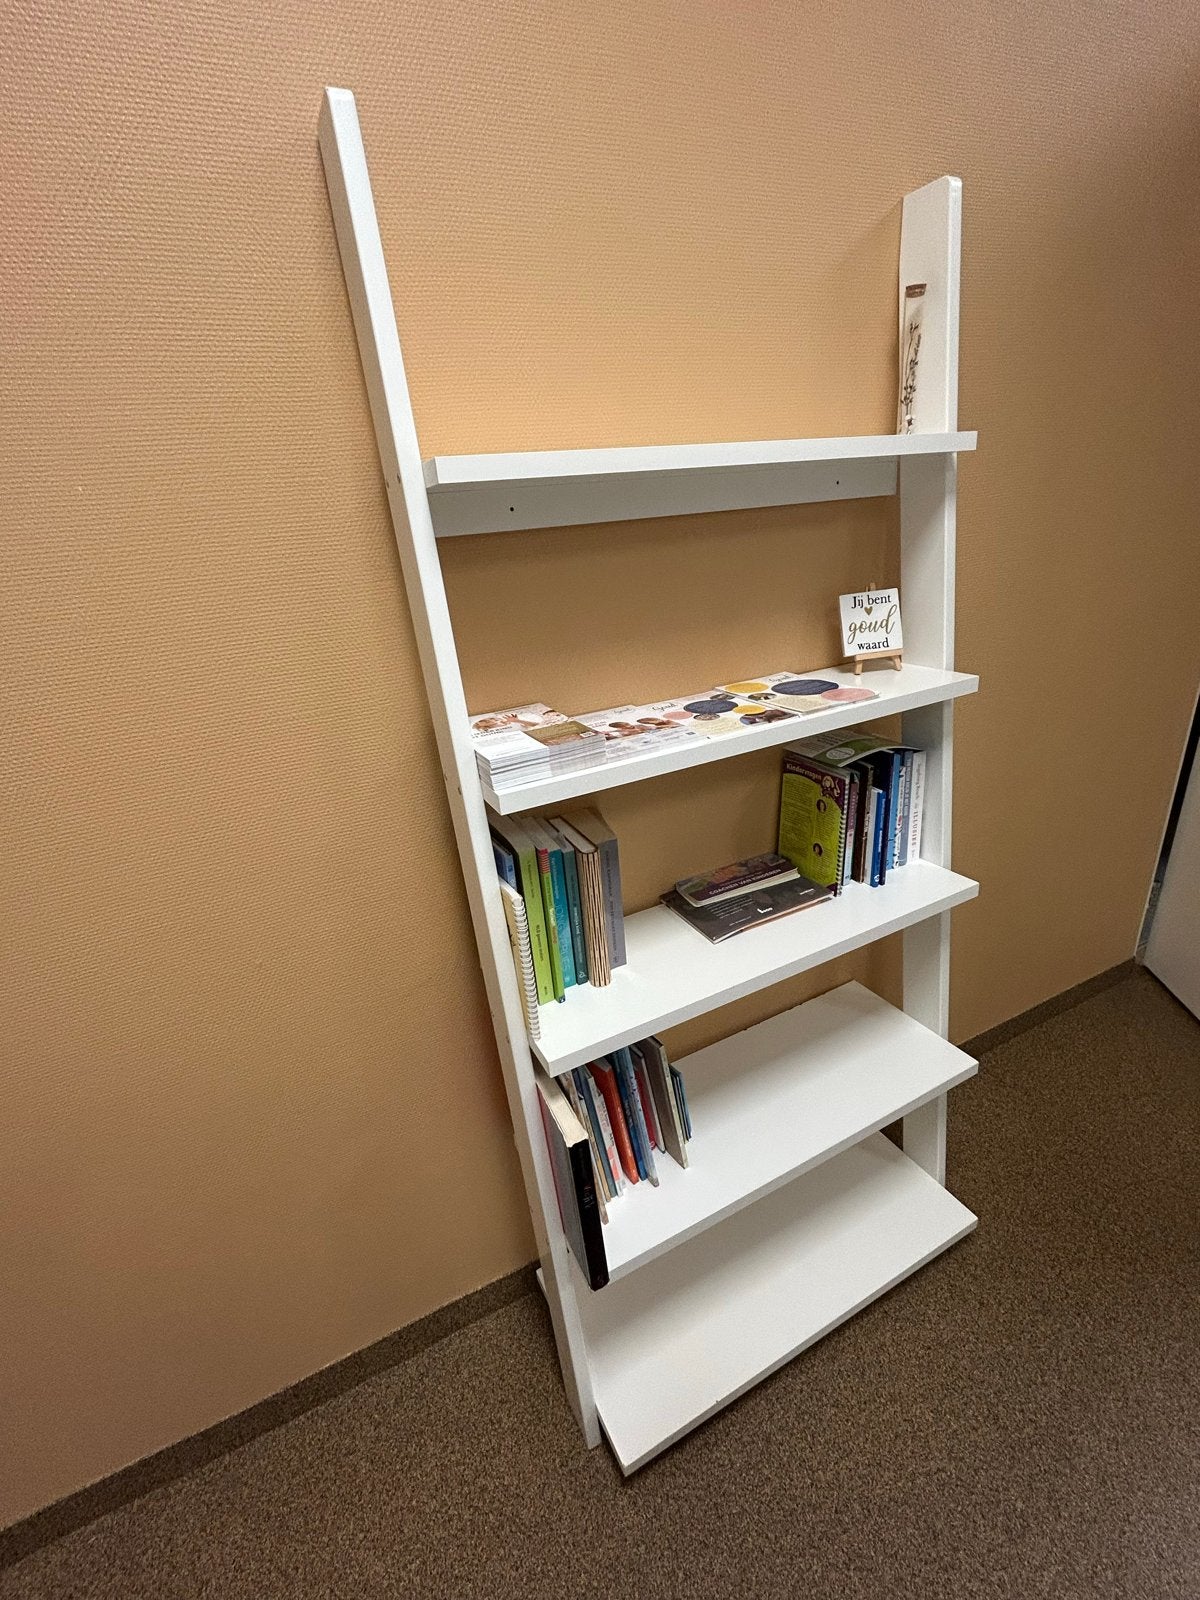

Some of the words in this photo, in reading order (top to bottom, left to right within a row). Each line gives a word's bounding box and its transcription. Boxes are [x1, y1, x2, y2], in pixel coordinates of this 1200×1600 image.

[851, 595, 864, 609] Jij
[867, 594, 891, 606] bent
[847, 604, 897, 644] goud
[857, 637, 890, 650] waard
[911, 811, 919, 846] ILLUSIES
[709, 883, 738, 895] COACHEN
